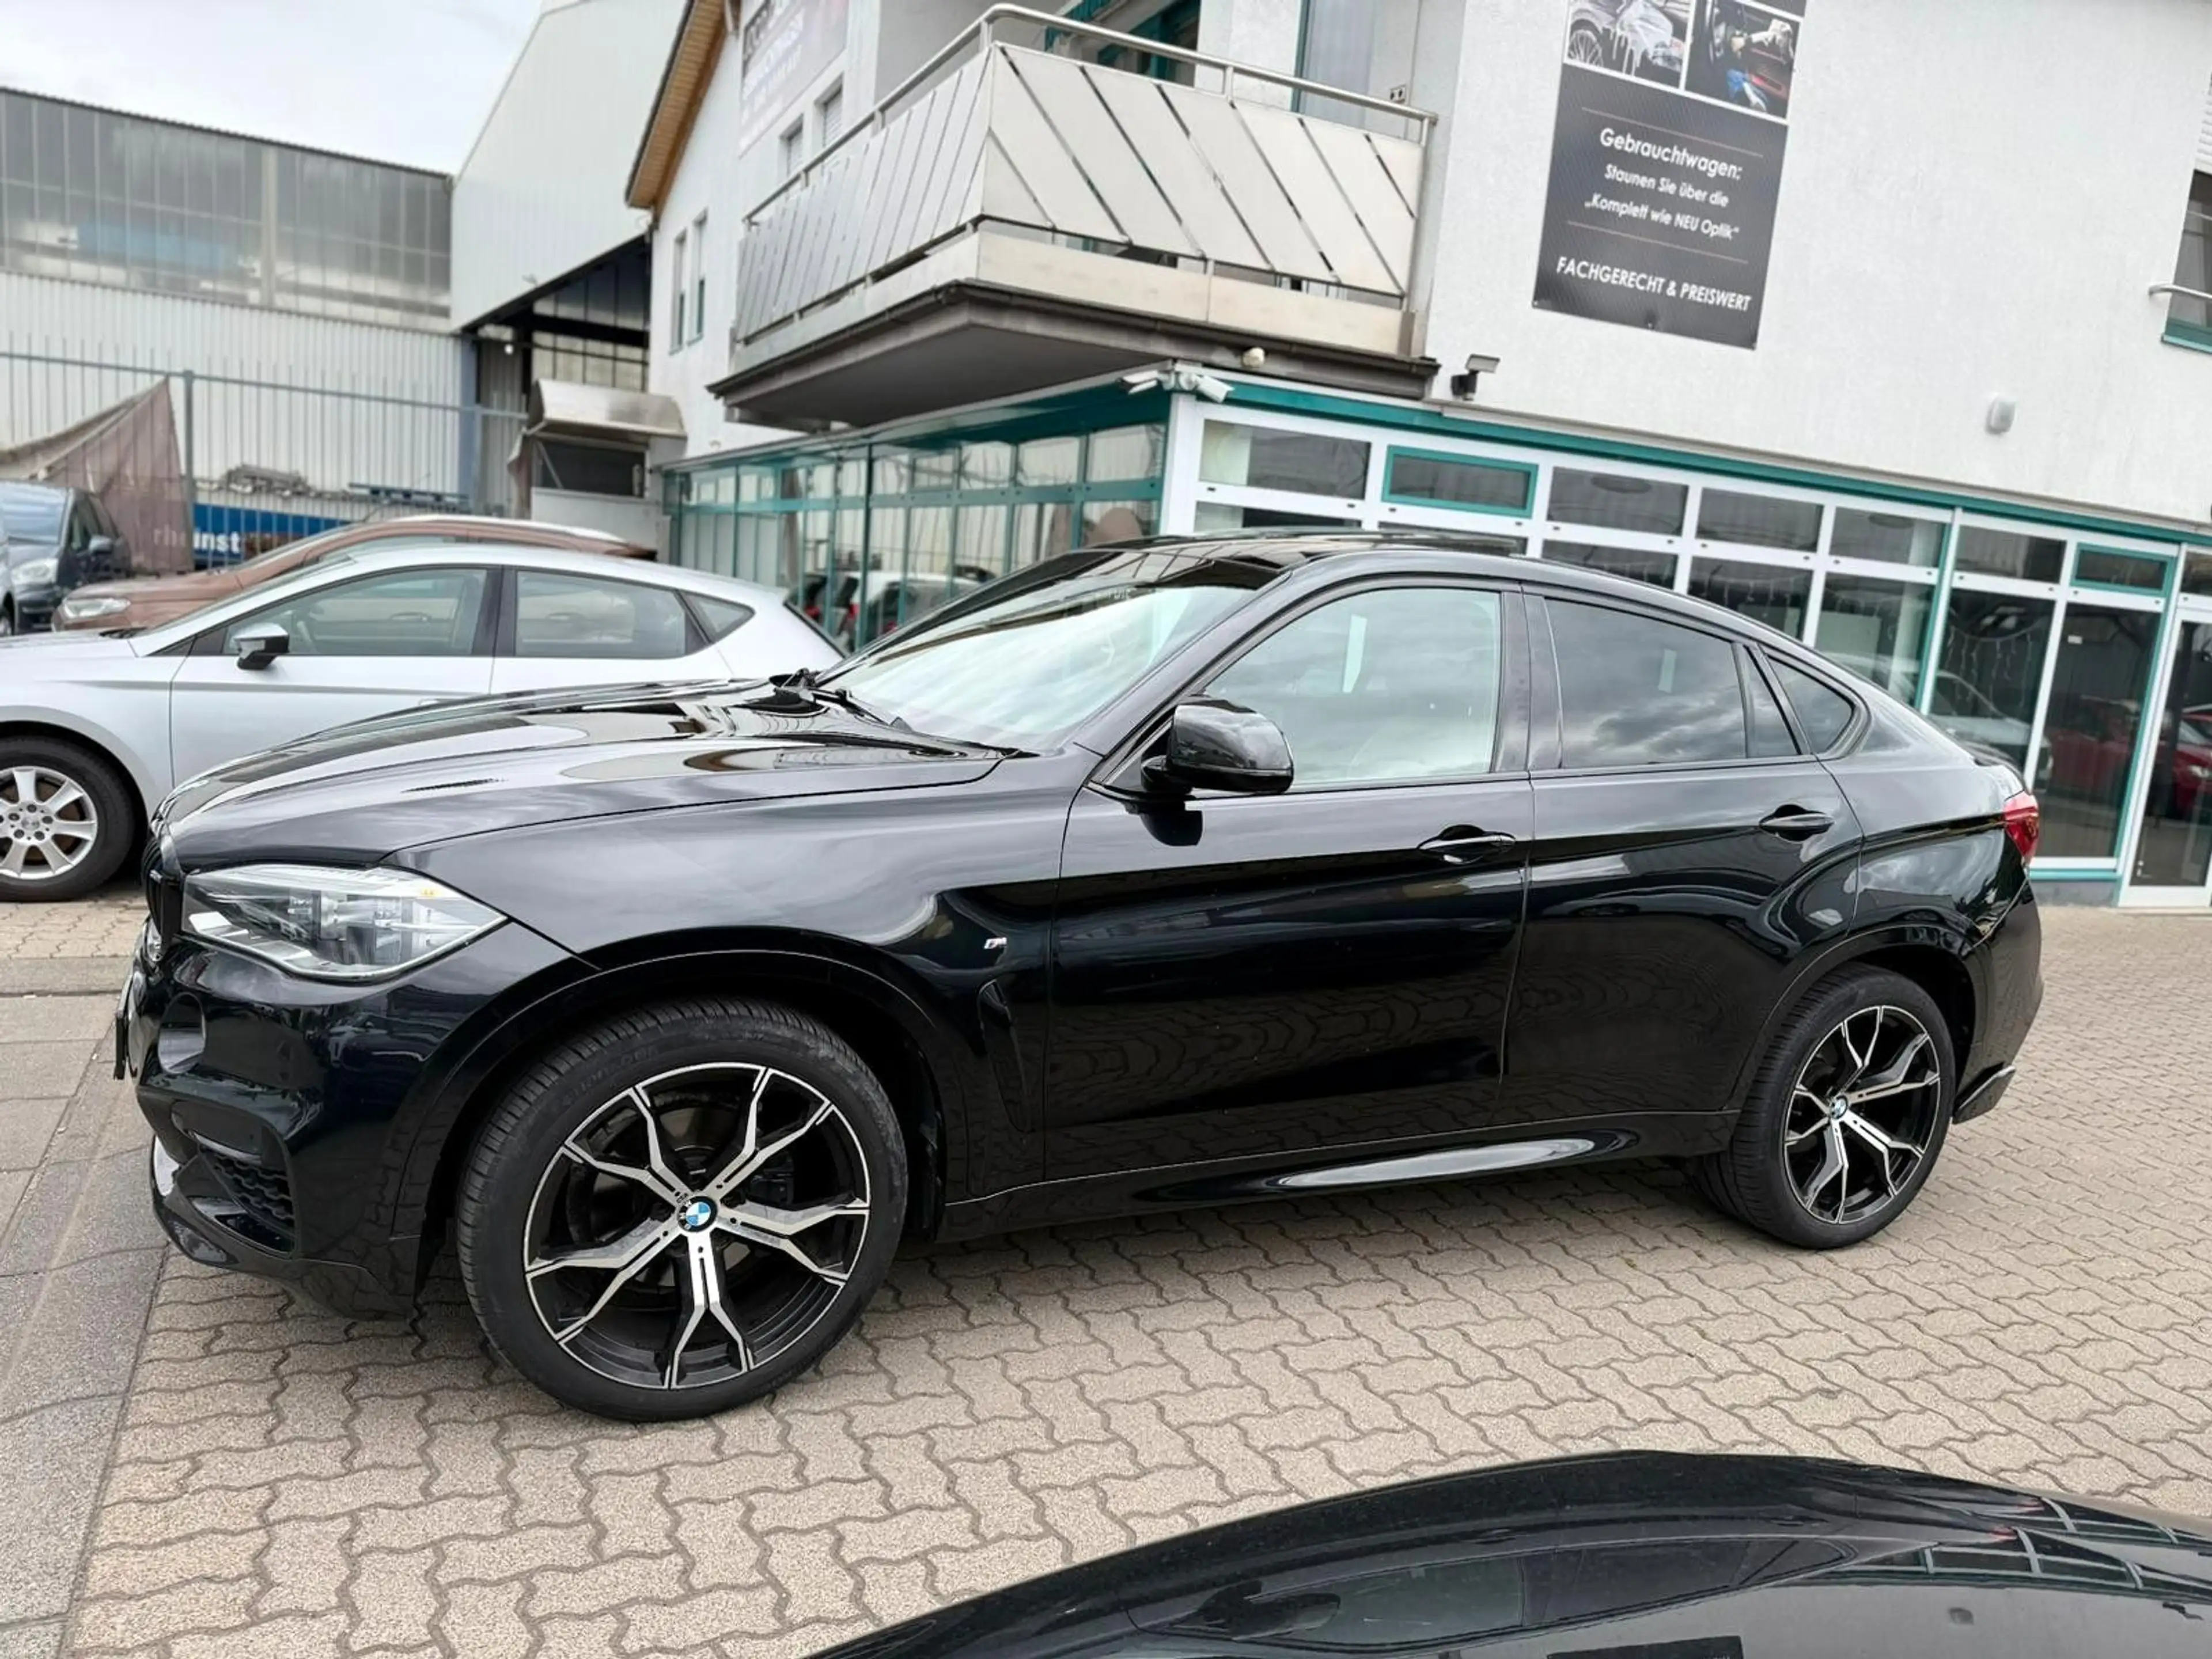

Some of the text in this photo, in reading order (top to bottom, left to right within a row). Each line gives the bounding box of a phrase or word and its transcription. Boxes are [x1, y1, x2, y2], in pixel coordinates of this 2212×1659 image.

[1600, 127, 1743, 180] Gebrauchtwagen:
[1604, 164, 1729, 207] Staunen Sie über die
[1650, 208, 1672, 225] wie
[1674, 211, 1700, 232] NEU
[1556, 256, 1752, 312] FACHGERECHT & PREISWERT
